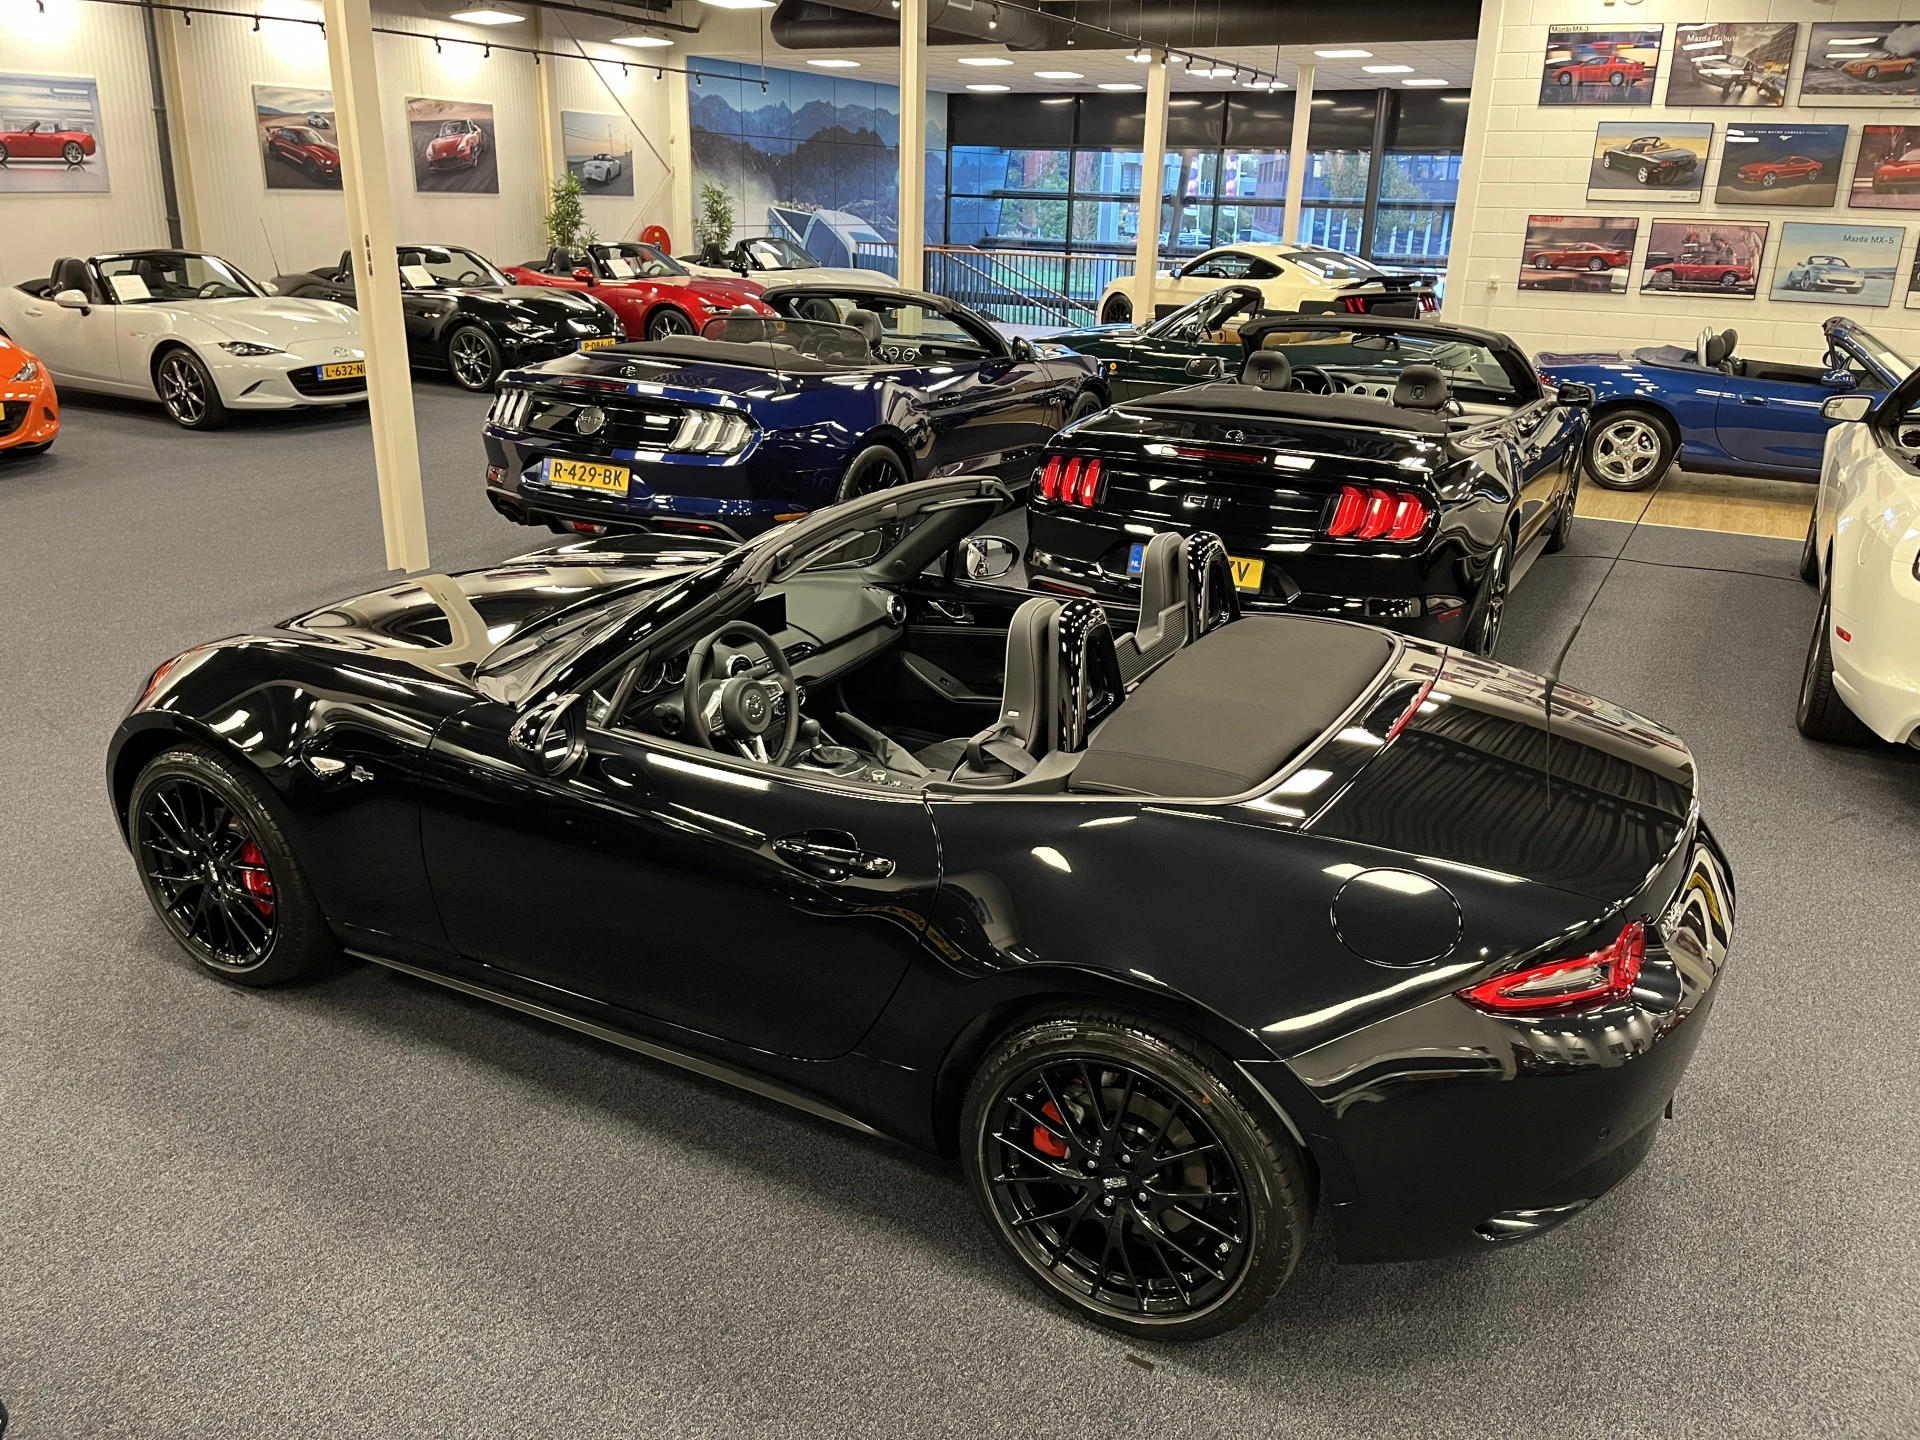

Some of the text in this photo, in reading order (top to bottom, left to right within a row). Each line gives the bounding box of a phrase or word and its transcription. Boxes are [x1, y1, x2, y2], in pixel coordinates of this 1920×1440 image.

[1687, 34, 1740, 42] Mazda Tribute
[1843, 235, 1894, 244] Mazda MX-5
[326, 364, 366, 378] L-632-N
[553, 462, 623, 487] R-429-BK
